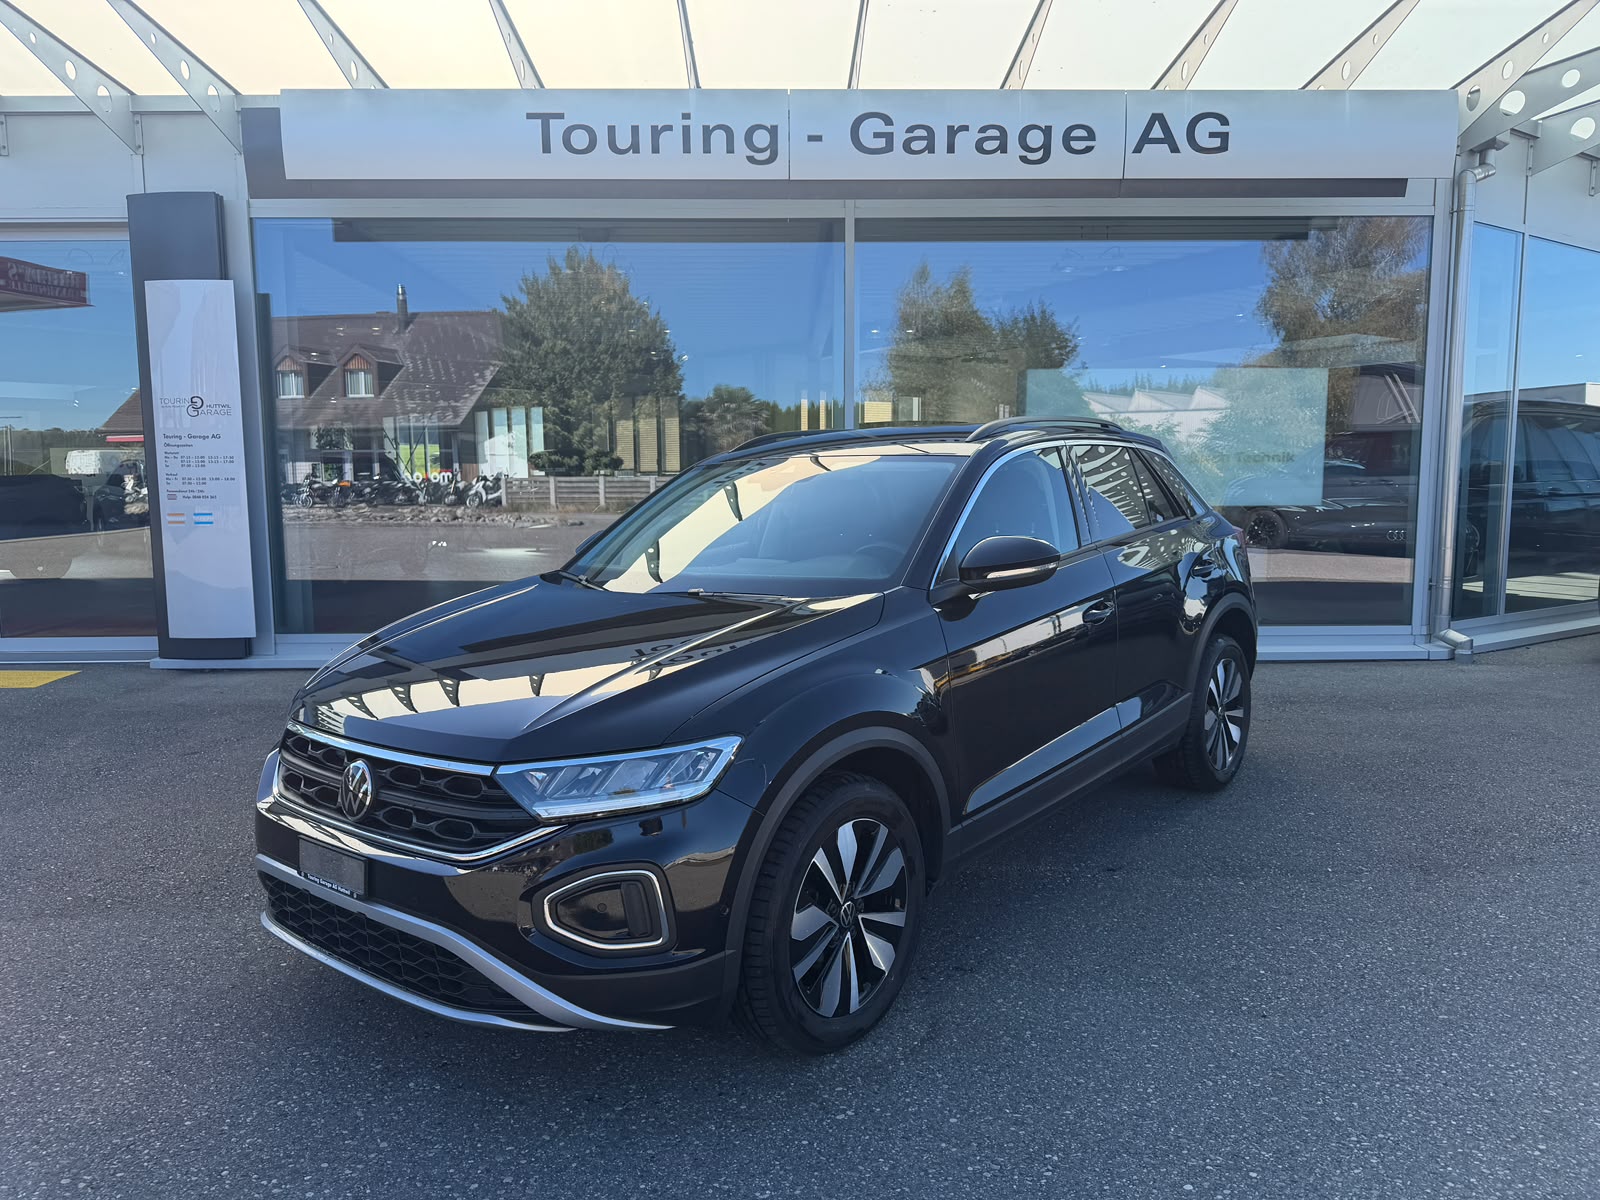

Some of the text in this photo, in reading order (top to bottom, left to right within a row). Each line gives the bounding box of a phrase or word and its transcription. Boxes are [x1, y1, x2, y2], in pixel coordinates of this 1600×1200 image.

[526, 111, 1230, 166] Touring - Garage AG
